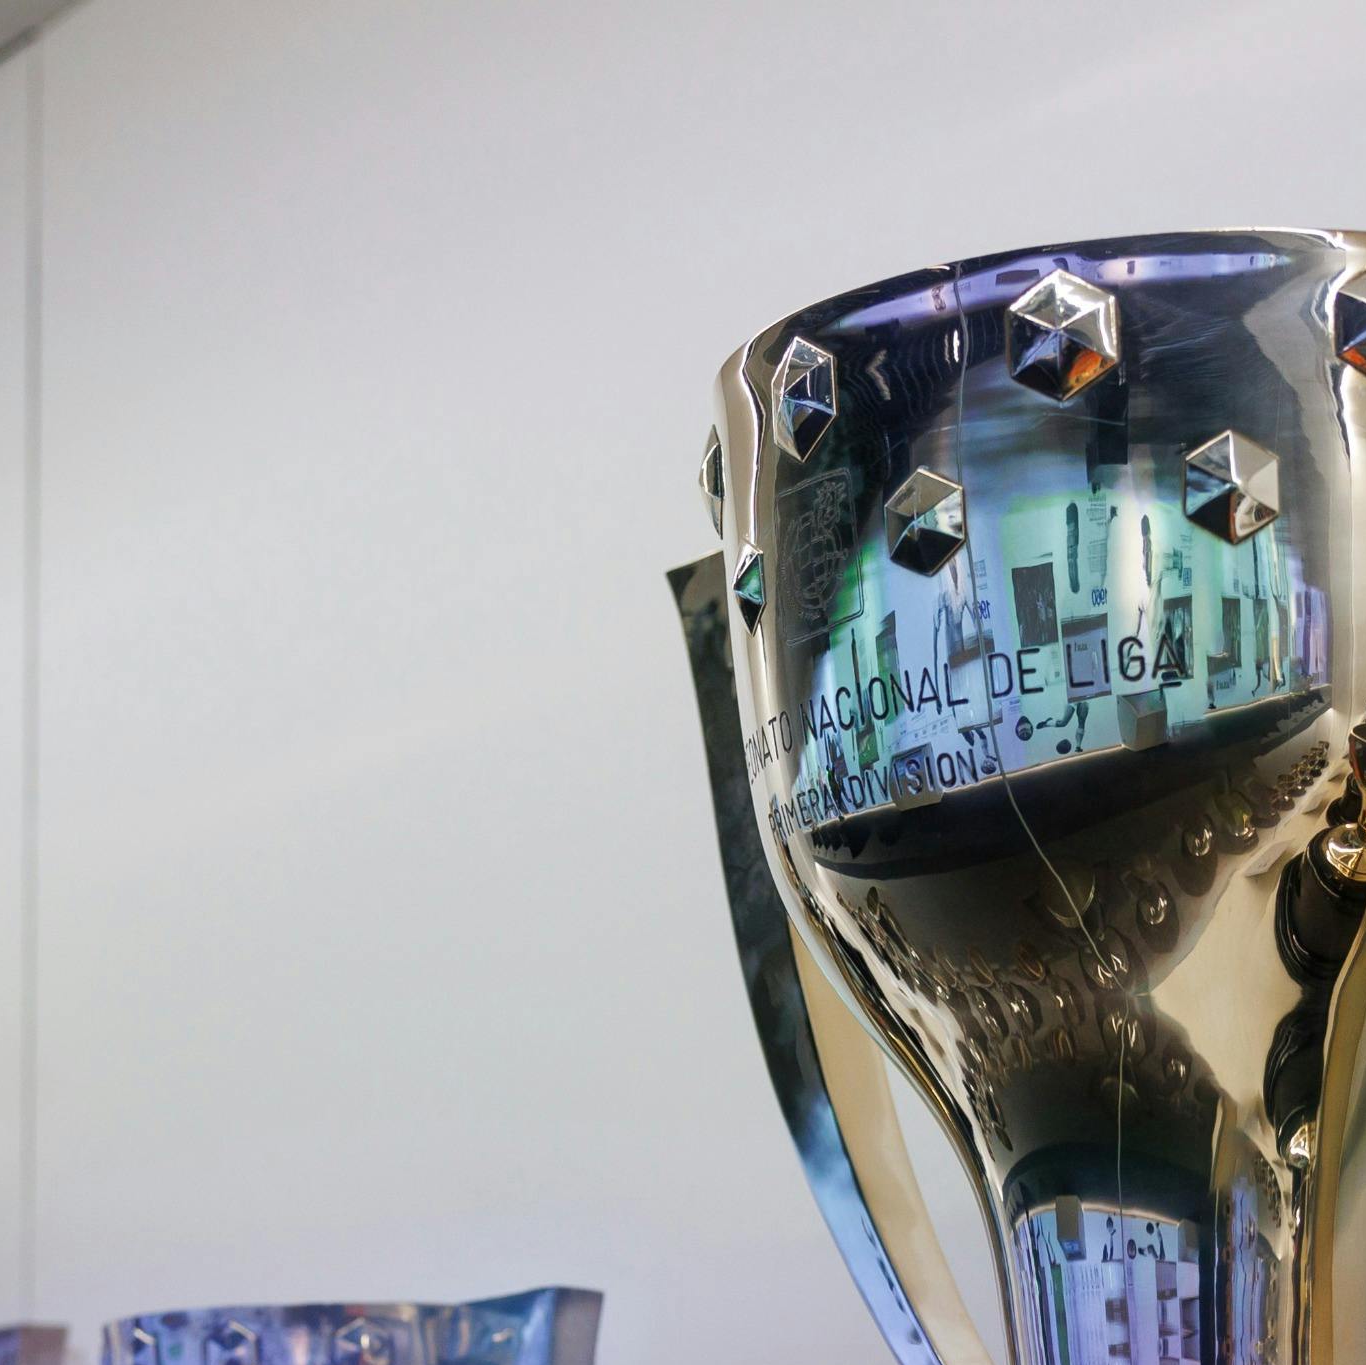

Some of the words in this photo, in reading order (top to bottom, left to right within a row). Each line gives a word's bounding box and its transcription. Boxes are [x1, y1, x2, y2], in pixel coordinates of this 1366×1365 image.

[799, 661, 969, 746] NACIONAL
[987, 647, 1044, 699] DE
[1066, 633, 1186, 689] LIGA
[847, 748, 979, 810] DIVISION
